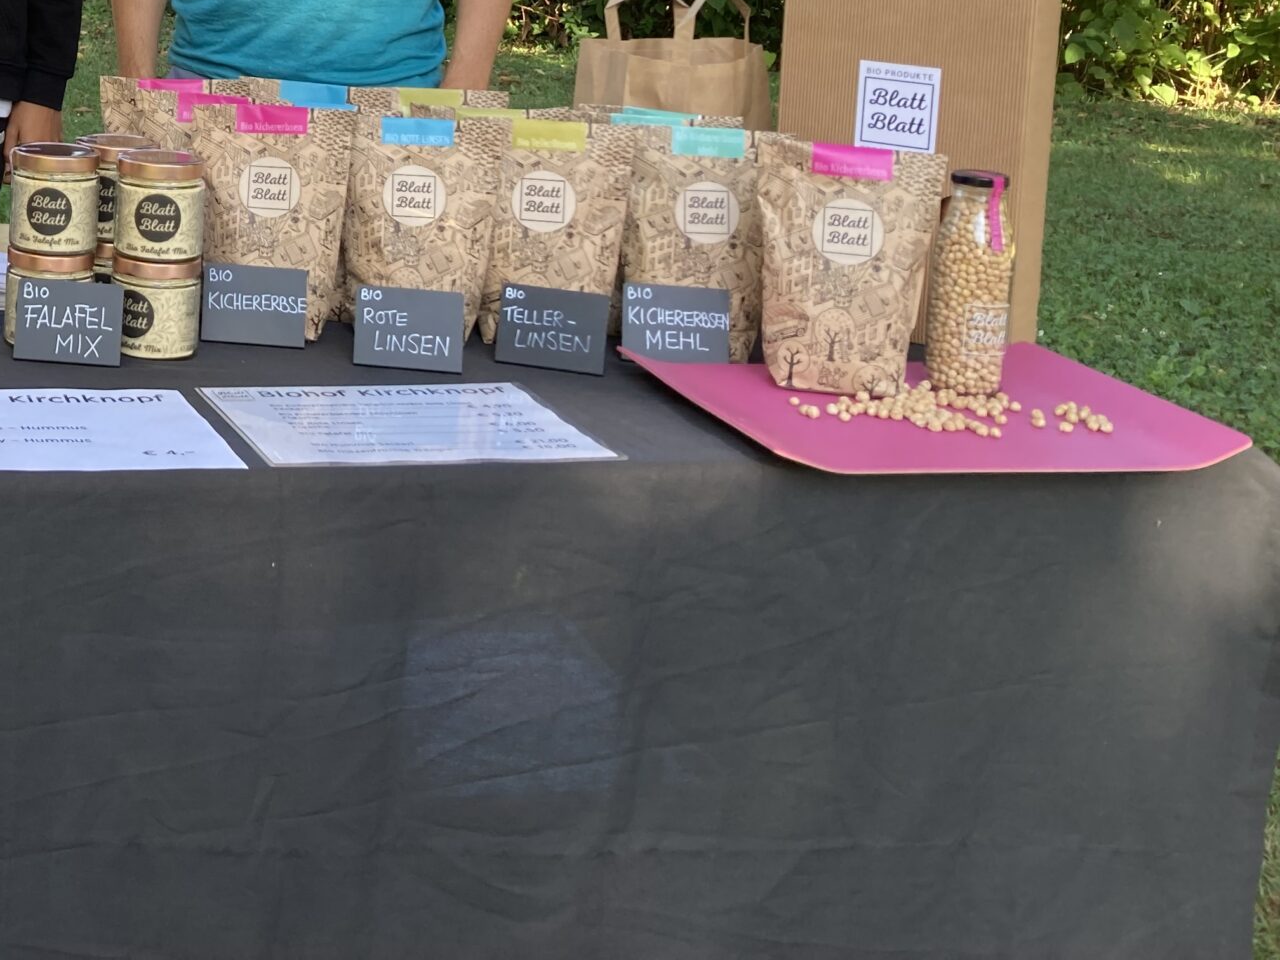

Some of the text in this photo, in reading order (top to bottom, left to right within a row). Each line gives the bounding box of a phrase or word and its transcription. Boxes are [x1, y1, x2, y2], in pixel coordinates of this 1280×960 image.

[866, 67, 934, 81] BIO PRODUKTE
[869, 88, 928, 110] Blatt
[868, 112, 926, 135] Blatt
[252, 171, 288, 185] Blatt
[252, 187, 288, 201] Blatt
[396, 180, 432, 194] Blatt
[524, 184, 561, 198] Blatt
[32, 194, 67, 209] Blatt
[140, 201, 176, 215] Blatt
[396, 196, 432, 209] Blatt
[524, 200, 561, 214] Blatt
[688, 196, 726, 209] Blatt
[31, 211, 66, 226] Blatt
[139, 218, 176, 232] Blatt
[688, 212, 726, 225] Blatt
[828, 214, 869, 230] Blatt
[827, 231, 869, 246] Blatt
[139, 245, 170, 256] Falafel
[172, 247, 187, 255] Mix
[209, 267, 233, 282] BIO
[23, 282, 50, 299] BIO
[360, 288, 382, 301] BIO
[505, 287, 526, 299] BIO
[627, 286, 653, 300] BIO
[124, 298, 149, 312] latt
[24, 304, 113, 331] FALAFEL
[123, 314, 148, 329] latt
[363, 307, 408, 326] ROTE
[628, 306, 729, 331] KICHERERBSEN
[971, 313, 1007, 327] Blatt
[374, 330, 450, 357] LINSEN
[514, 329, 591, 353] LINSEN
[646, 330, 709, 352] MEHL
[970, 330, 1006, 345] Blatt
[55, 335, 102, 358] MIX
[8, 393, 164, 404] Kirchknopf
[256, 385, 504, 398] Biohof Kirchknopf
